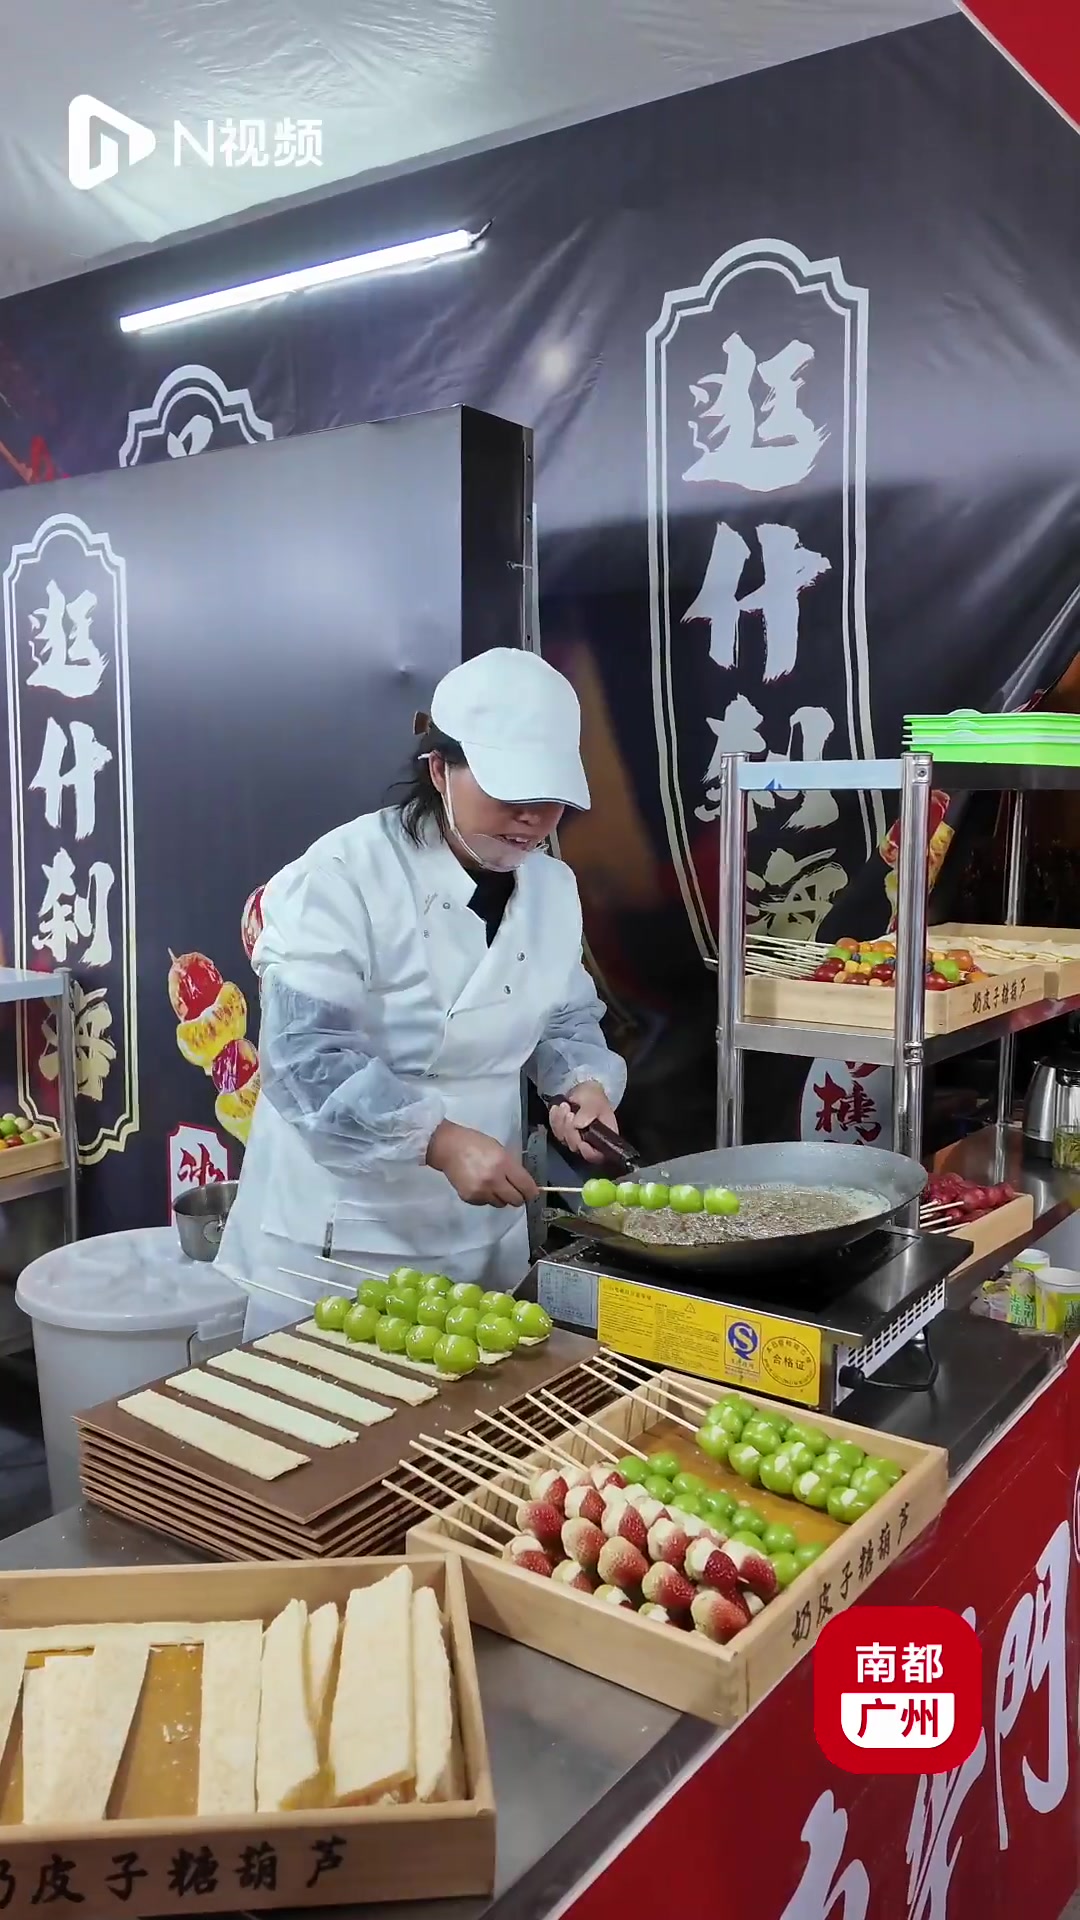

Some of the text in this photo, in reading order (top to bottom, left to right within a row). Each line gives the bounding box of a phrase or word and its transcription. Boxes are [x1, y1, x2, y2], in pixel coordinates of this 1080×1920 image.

[28, 577, 117, 1101] 逛什刹海
[773, 1353, 806, 1371] 合格证
[791, 1502, 910, 1648] 奶皮子糖葫芦
